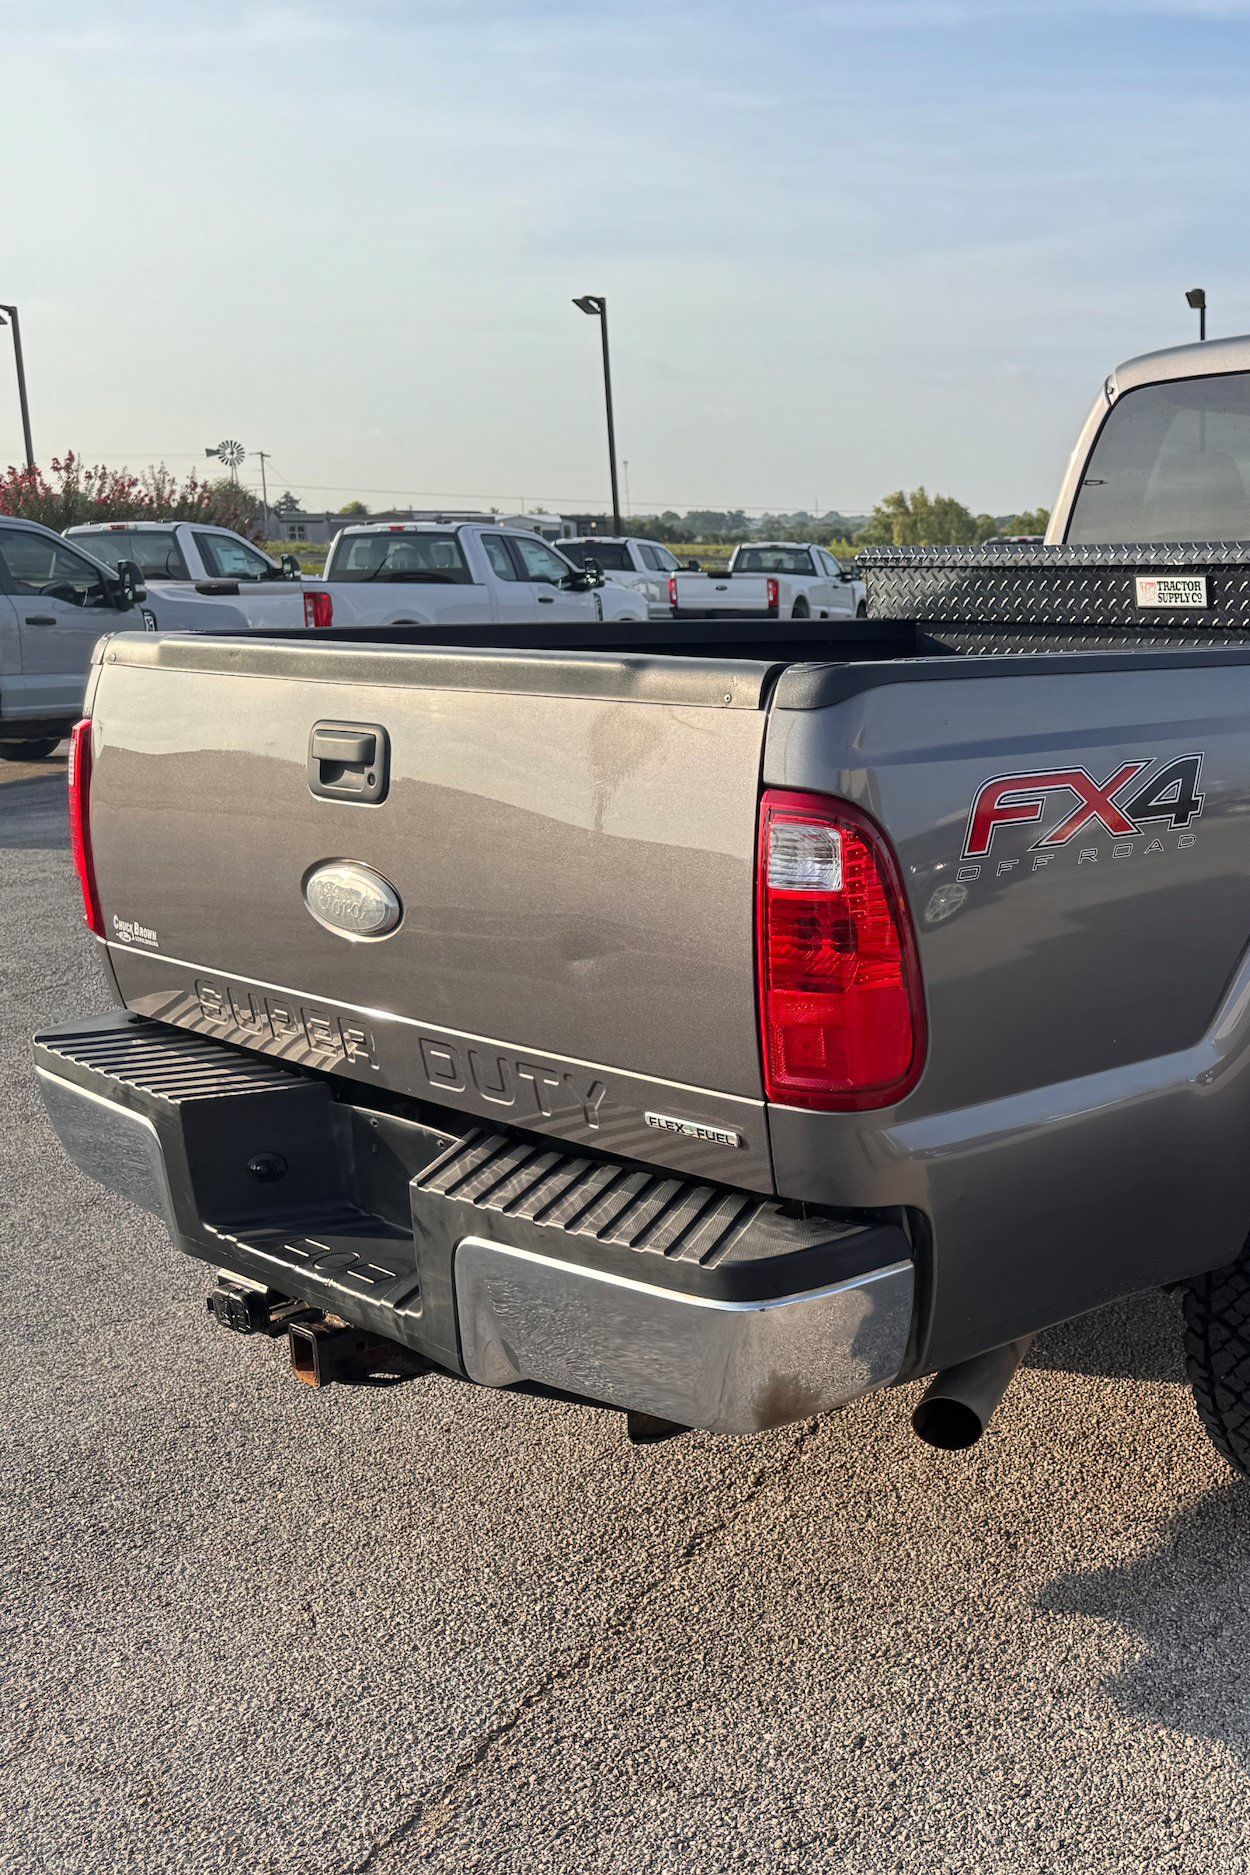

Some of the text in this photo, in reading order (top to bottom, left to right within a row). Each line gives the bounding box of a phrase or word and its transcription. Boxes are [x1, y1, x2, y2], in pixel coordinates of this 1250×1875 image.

[1157, 581, 1202, 592] TRACTOR
[1158, 593, 1191, 603] SUPPLY
[960, 752, 1206, 860] FX4
[956, 834, 1197, 882] OFF ROAD
[311, 880, 368, 921] Ford
[133, 921, 157, 941] BROWN
[194, 978, 606, 1130] SUPER DUTY
[648, 1116, 735, 1147] FLEX FUEL
